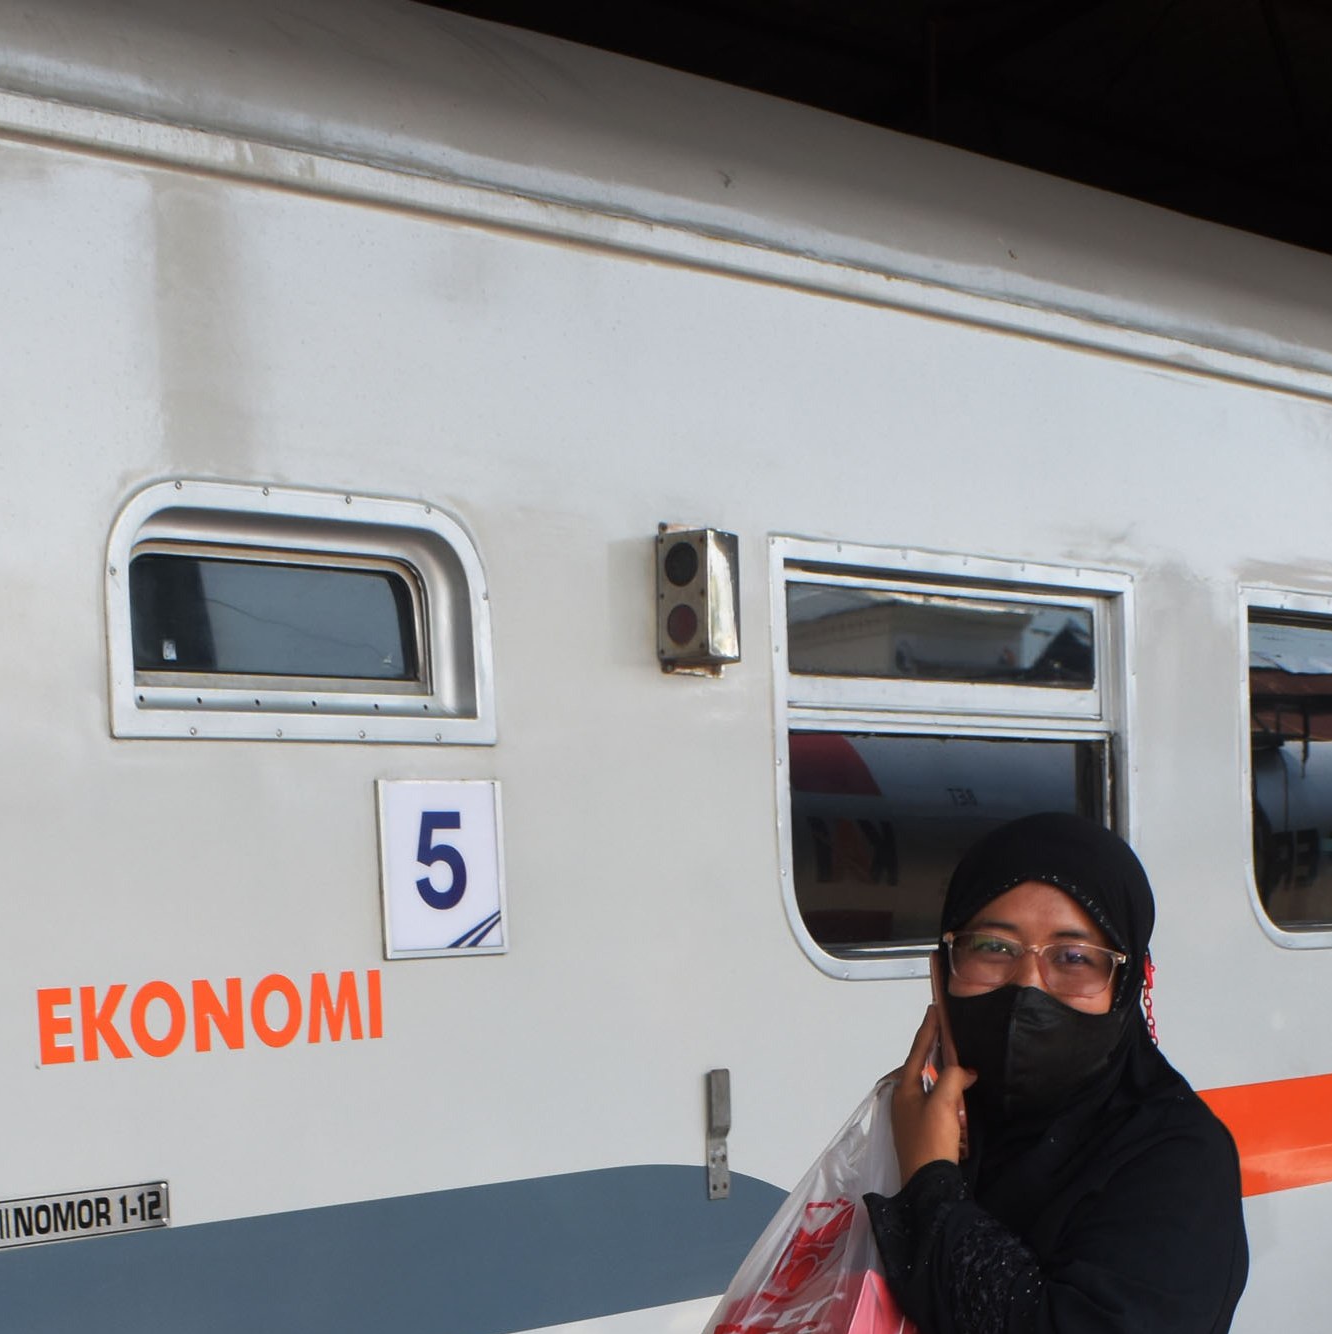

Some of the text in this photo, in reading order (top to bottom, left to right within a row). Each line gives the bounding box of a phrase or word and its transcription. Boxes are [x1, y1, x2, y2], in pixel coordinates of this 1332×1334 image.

[415, 810, 468, 911] 5
[36, 969, 383, 1066] EKONOMI
[14, 1190, 162, 1238] NOMOR 1-12
